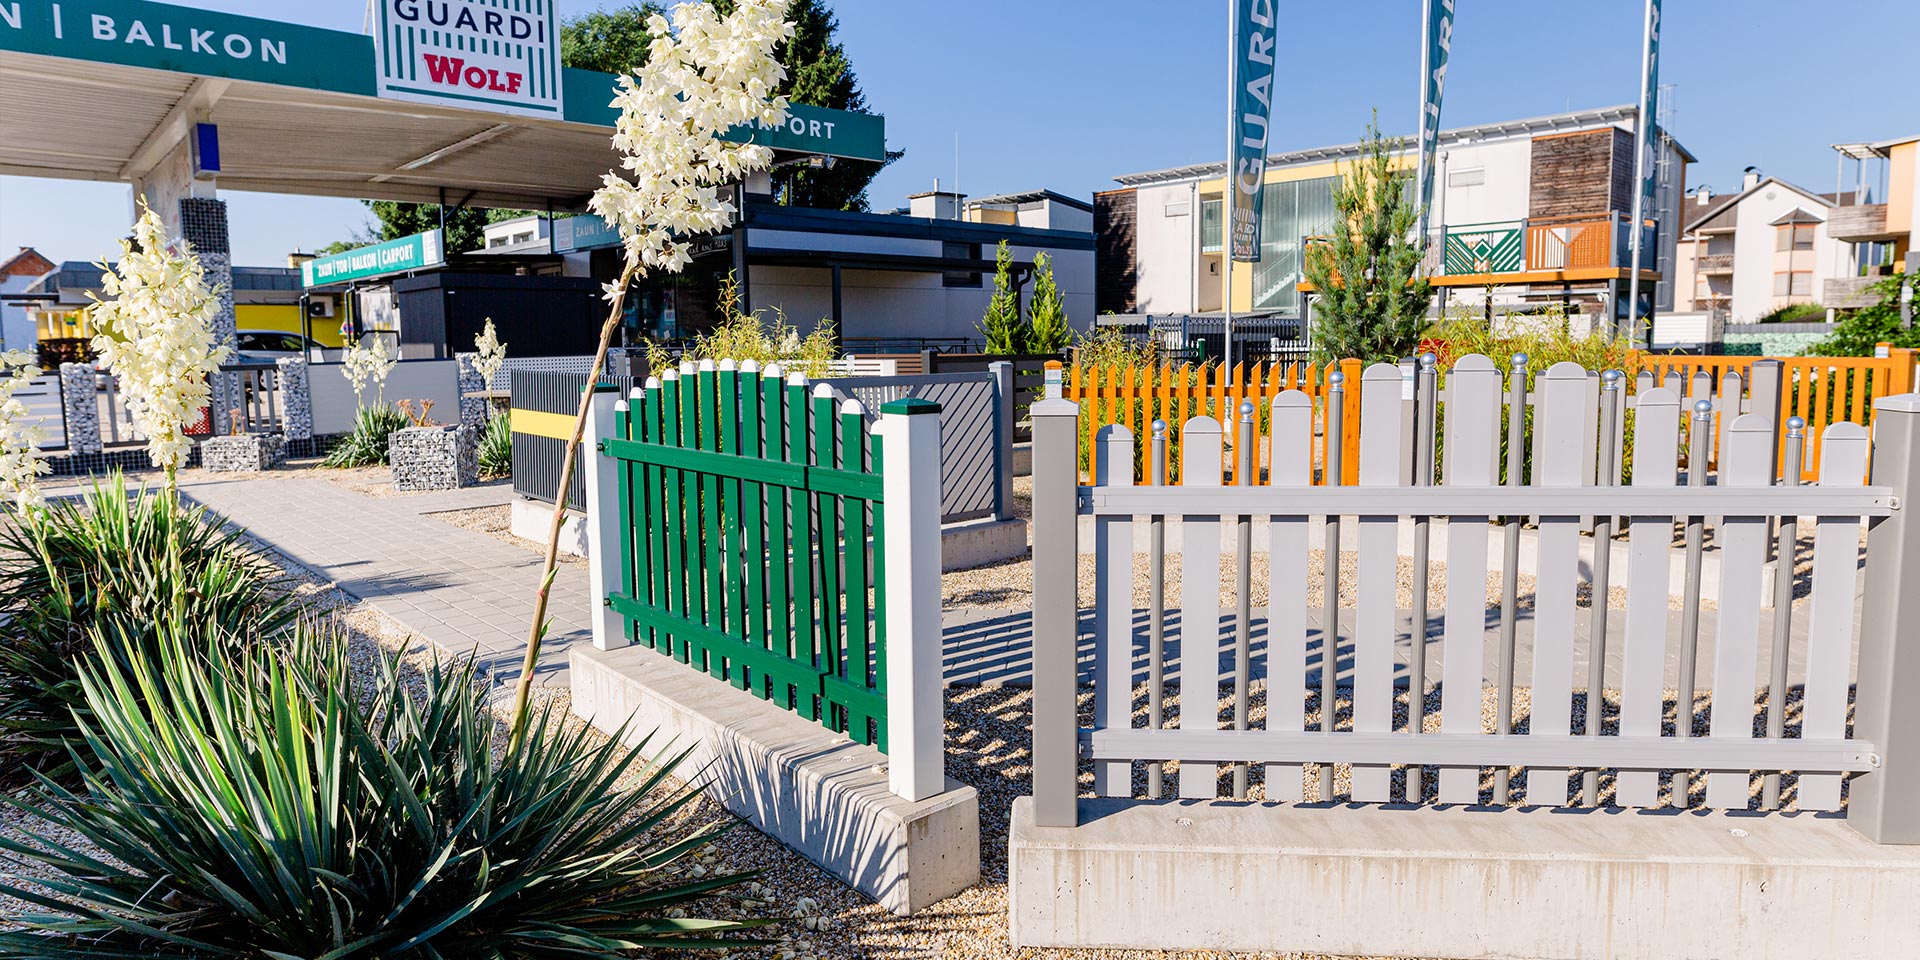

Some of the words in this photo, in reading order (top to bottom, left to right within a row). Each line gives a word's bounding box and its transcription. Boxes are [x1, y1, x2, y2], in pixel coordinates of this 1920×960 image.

[91, 13, 287, 65] BALKON
[394, 0, 544, 43] GUARDI
[423, 53, 523, 95] WOLF
[576, 223, 595, 238] ZAUN
[318, 262, 333, 278] ZAUN
[336, 258, 348, 273] TOR
[352, 252, 377, 271] BALKON
[382, 244, 414, 265] CARPORT
